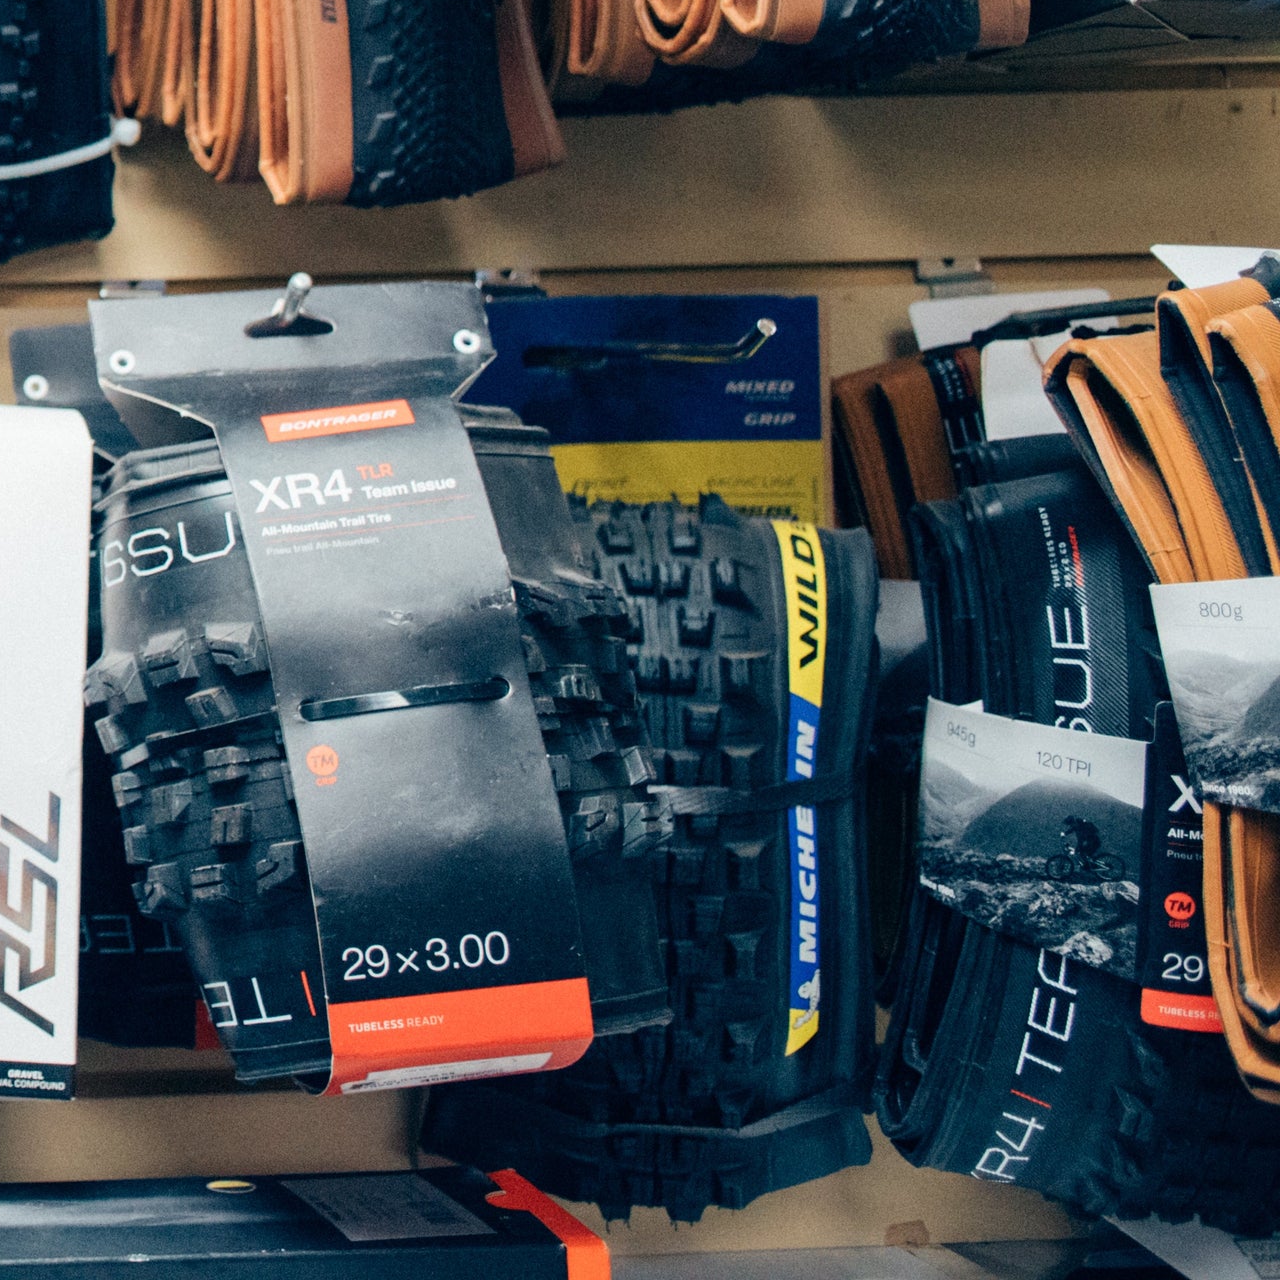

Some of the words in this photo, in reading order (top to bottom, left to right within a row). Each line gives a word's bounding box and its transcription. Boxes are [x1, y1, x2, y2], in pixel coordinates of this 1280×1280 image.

[725, 379, 795, 394] MIXED
[278, 408, 397, 433] BONTRAGER
[743, 412, 796, 426] GRIP
[356, 463, 394, 480] TLR
[249, 469, 353, 514] XR4
[361, 482, 409, 500] Team
[411, 476, 456, 494] Issue
[261, 517, 338, 537] All-Mountain
[338, 514, 366, 530] Trail
[367, 513, 392, 525] Tire
[790, 537, 821, 670] WILD
[1199, 602, 1244, 622] 800g
[945, 721, 977, 748] 945g
[1035, 750, 1063, 773] 120
[1064, 754, 1093, 778] TPI
[1167, 920, 1190, 929] GRIP
[341, 946, 391, 982] 29
[398, 950, 420, 973] x
[425, 930, 510, 971] 3.00
[1161, 952, 1205, 982] 29
[1158, 1005, 1206, 1019] TUBELESS
[348, 1019, 404, 1034] TUBELESS
[406, 1014, 445, 1028] READY
[7, 1068, 44, 1080] GRAVEL
[14, 1079, 65, 1091] COMPOUND
